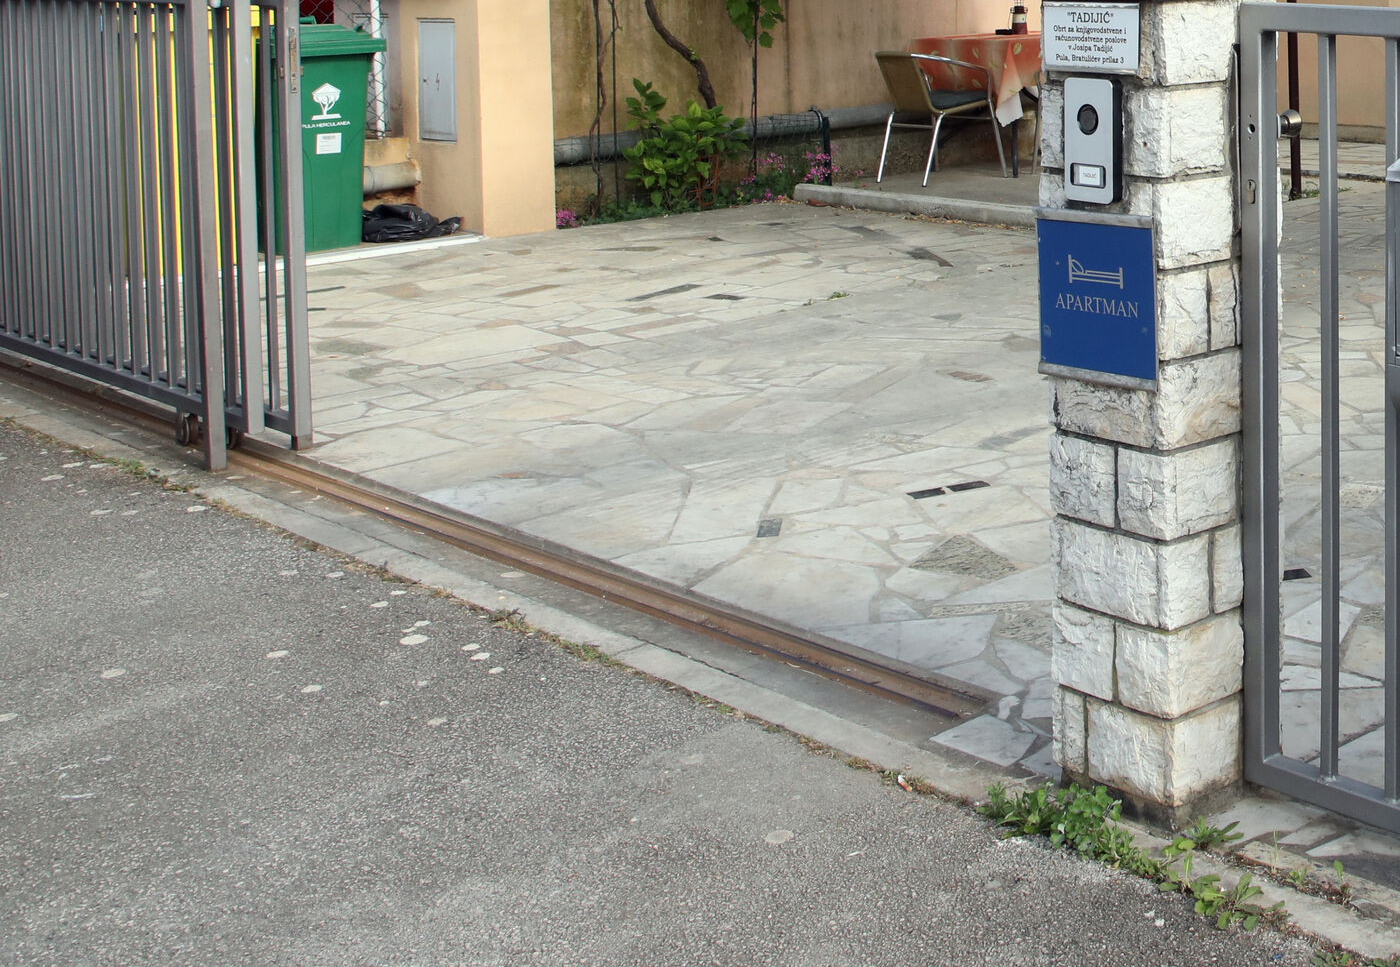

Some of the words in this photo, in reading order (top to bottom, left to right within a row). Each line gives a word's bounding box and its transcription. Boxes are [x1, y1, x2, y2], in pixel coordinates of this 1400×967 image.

[1076, 26, 1122, 35] knjigovodstvene
[1055, 34, 1103, 43] računovodstvene
[1105, 36, 1127, 45] poslove
[1056, 53, 1070, 62] Pula,
[1102, 56, 1119, 64] prilaz
[1055, 292, 1138, 318] APARTMAN
